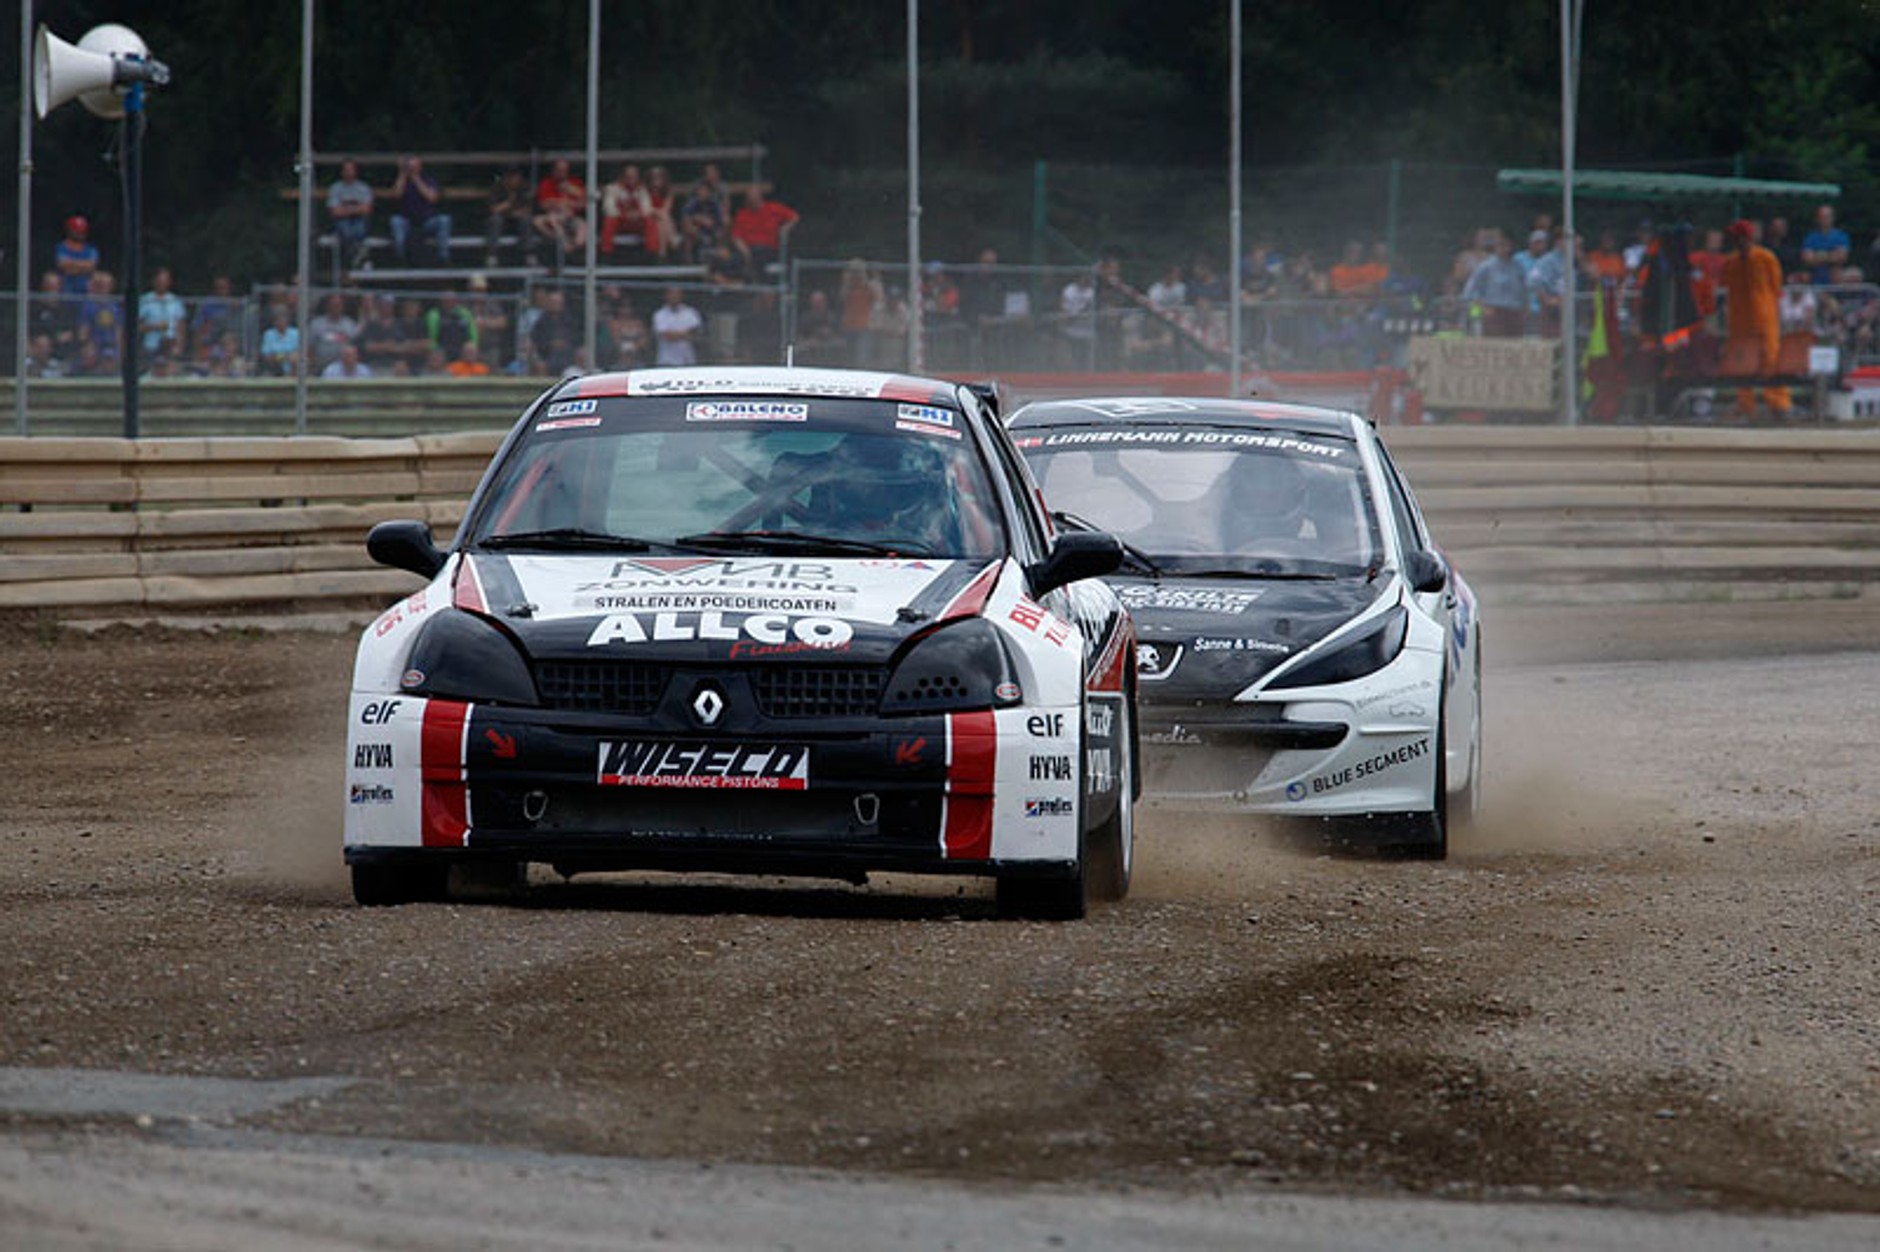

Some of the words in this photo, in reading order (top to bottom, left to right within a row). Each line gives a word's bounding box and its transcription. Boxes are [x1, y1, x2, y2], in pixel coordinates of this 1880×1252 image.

[718, 402, 805, 415] BALENO
[1046, 432, 1179, 447] LINNEMANN
[1184, 432, 1345, 458] MOTORSPORT
[594, 596, 669, 609] STRALEN
[673, 597, 696, 609] EN
[700, 596, 837, 613] POEDERCOATEN
[586, 612, 854, 651] ALLCO
[361, 700, 403, 725] elf
[1026, 714, 1065, 737] elf
[354, 744, 394, 769] HYVA
[601, 741, 807, 778] WISECO
[1028, 755, 1072, 782] HYVA
[1313, 768, 1352, 793] BLUE
[1356, 738, 1429, 778] SEGMENT
[617, 773, 719, 789] PERFORMANCE
[720, 775, 780, 790] PISTONS
